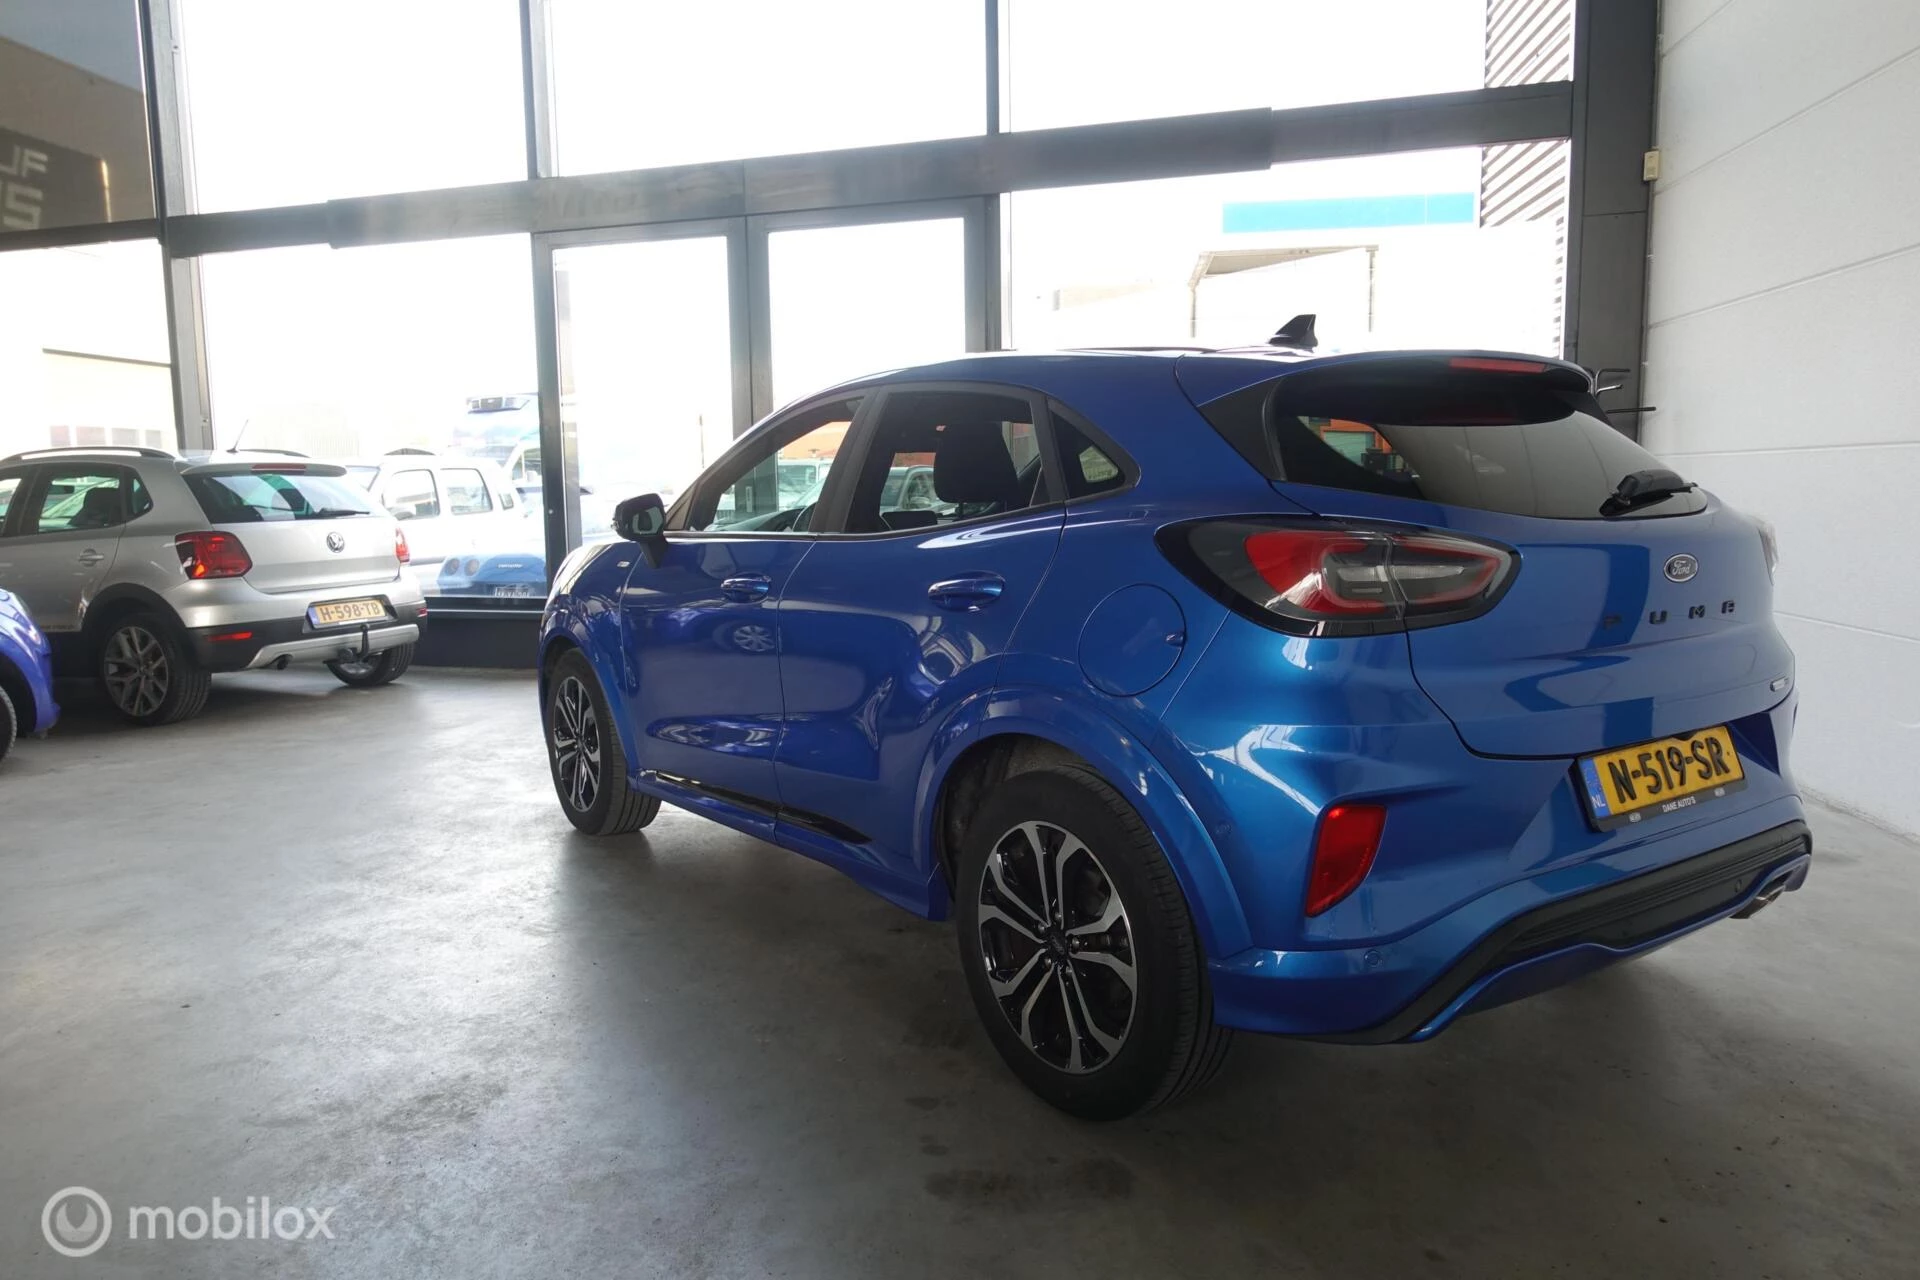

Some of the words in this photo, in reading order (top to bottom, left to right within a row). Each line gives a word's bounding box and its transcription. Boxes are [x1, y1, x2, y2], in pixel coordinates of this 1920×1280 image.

[1671, 559, 1692, 576] Ford
[320, 602, 381, 621] H-598-TB
[1608, 736, 1730, 804] N-519-SR
[1592, 796, 1606, 809] NL
